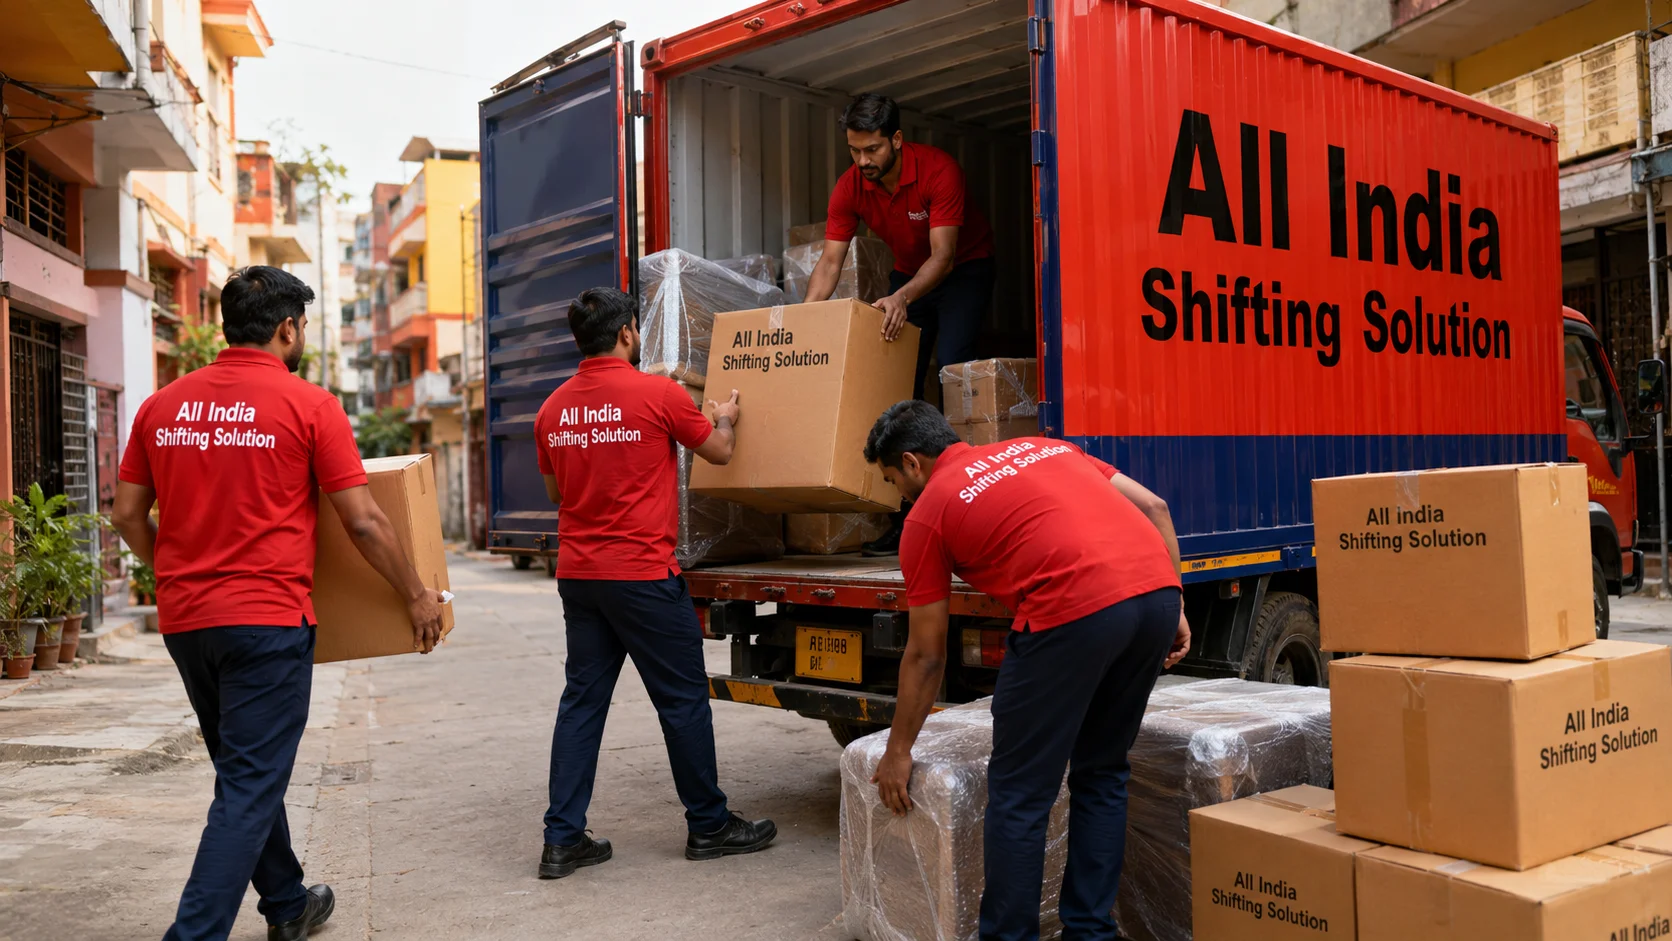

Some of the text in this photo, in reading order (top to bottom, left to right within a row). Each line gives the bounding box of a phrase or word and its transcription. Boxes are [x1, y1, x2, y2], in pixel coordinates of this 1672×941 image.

[1158, 109, 1502, 281] All India
[1141, 267, 1511, 367] Shifting Solution
[732, 328, 793, 348] All India
[722, 350, 829, 372] Shifting Solution
[175, 401, 256, 422] All India
[559, 403, 622, 427] All India
[155, 427, 276, 450] Shifting Solution
[547, 427, 641, 449] Shifting Solution
[964, 441, 1036, 479] All India
[959, 444, 1072, 503] Shifting Solution
[1366, 507, 1389, 526] All
[1339, 528, 1487, 553] Shifting Solution
[1564, 702, 1629, 735] All India
[1540, 727, 1658, 769] Shifting Solution
[1234, 871, 1297, 900] All India
[1211, 888, 1328, 932] Shifting Solution
[1633, 915, 1670, 941] India
